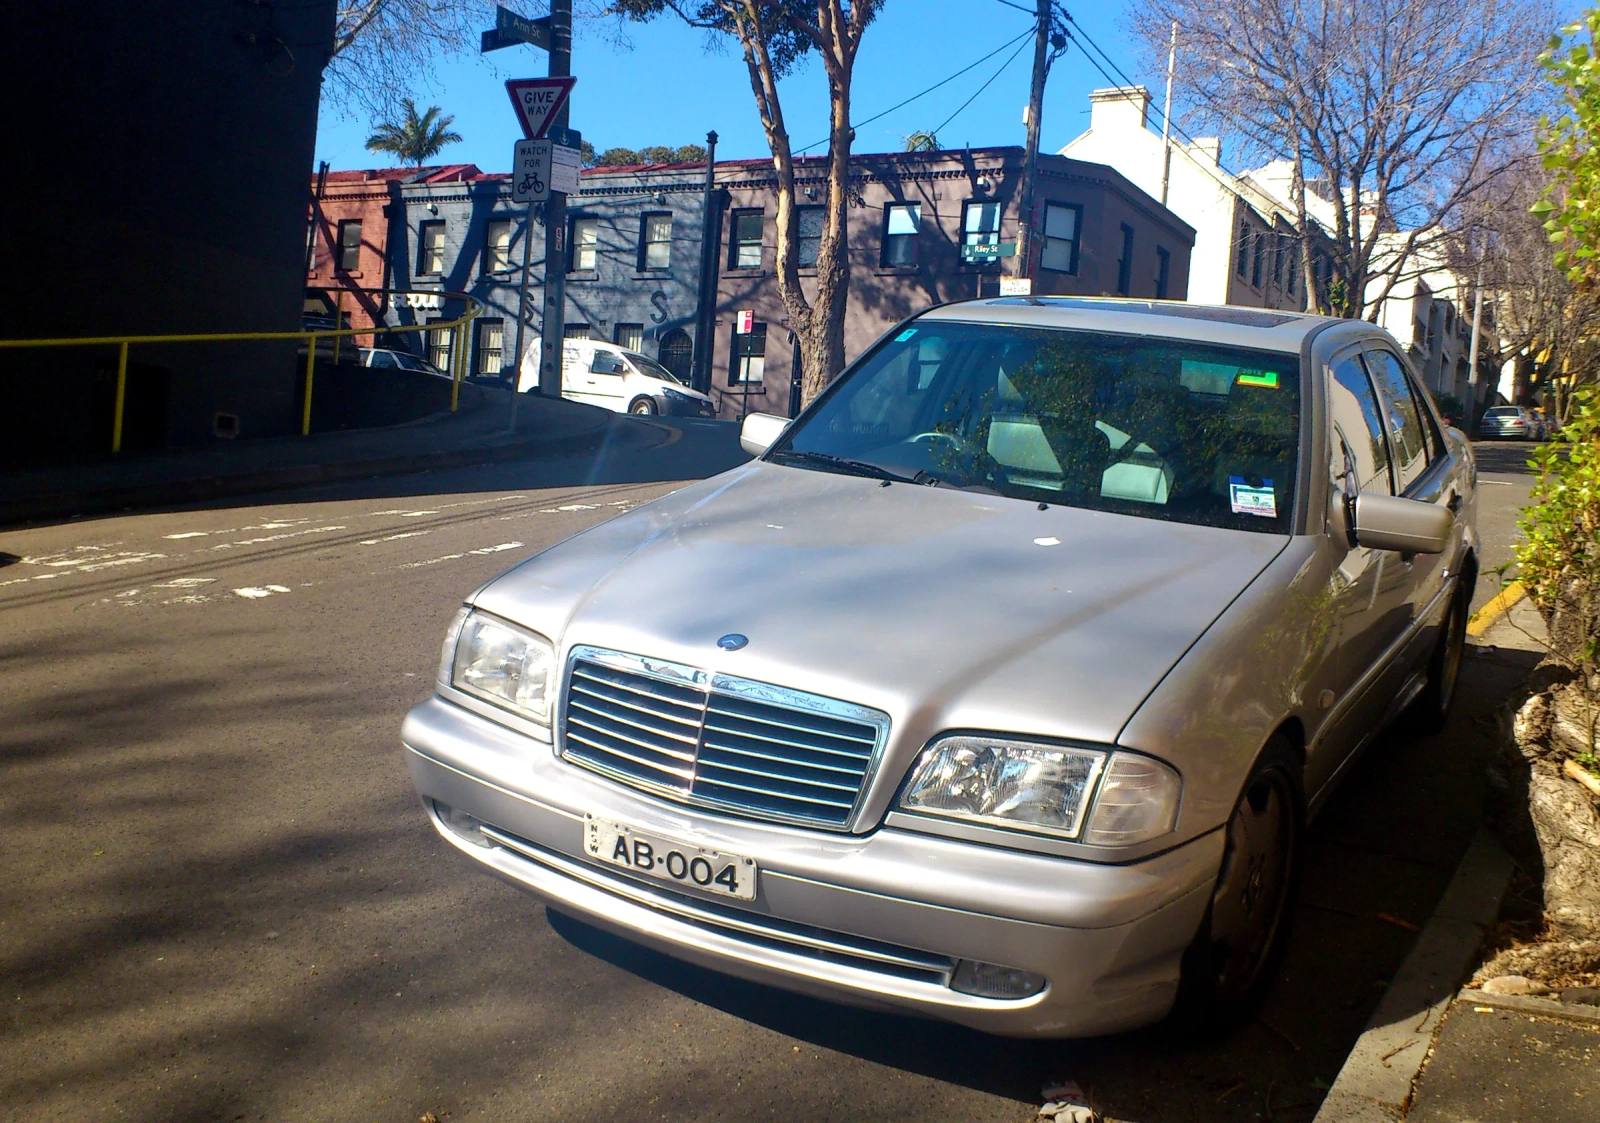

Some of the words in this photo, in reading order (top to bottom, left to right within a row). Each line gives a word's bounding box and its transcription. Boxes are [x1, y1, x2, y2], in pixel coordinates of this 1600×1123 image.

[524, 91, 554, 104] GIVE
[527, 106, 549, 116] WAY
[520, 146, 547, 156] WATCH
[524, 159, 540, 168] FOR
[974, 245, 990, 254] Riley
